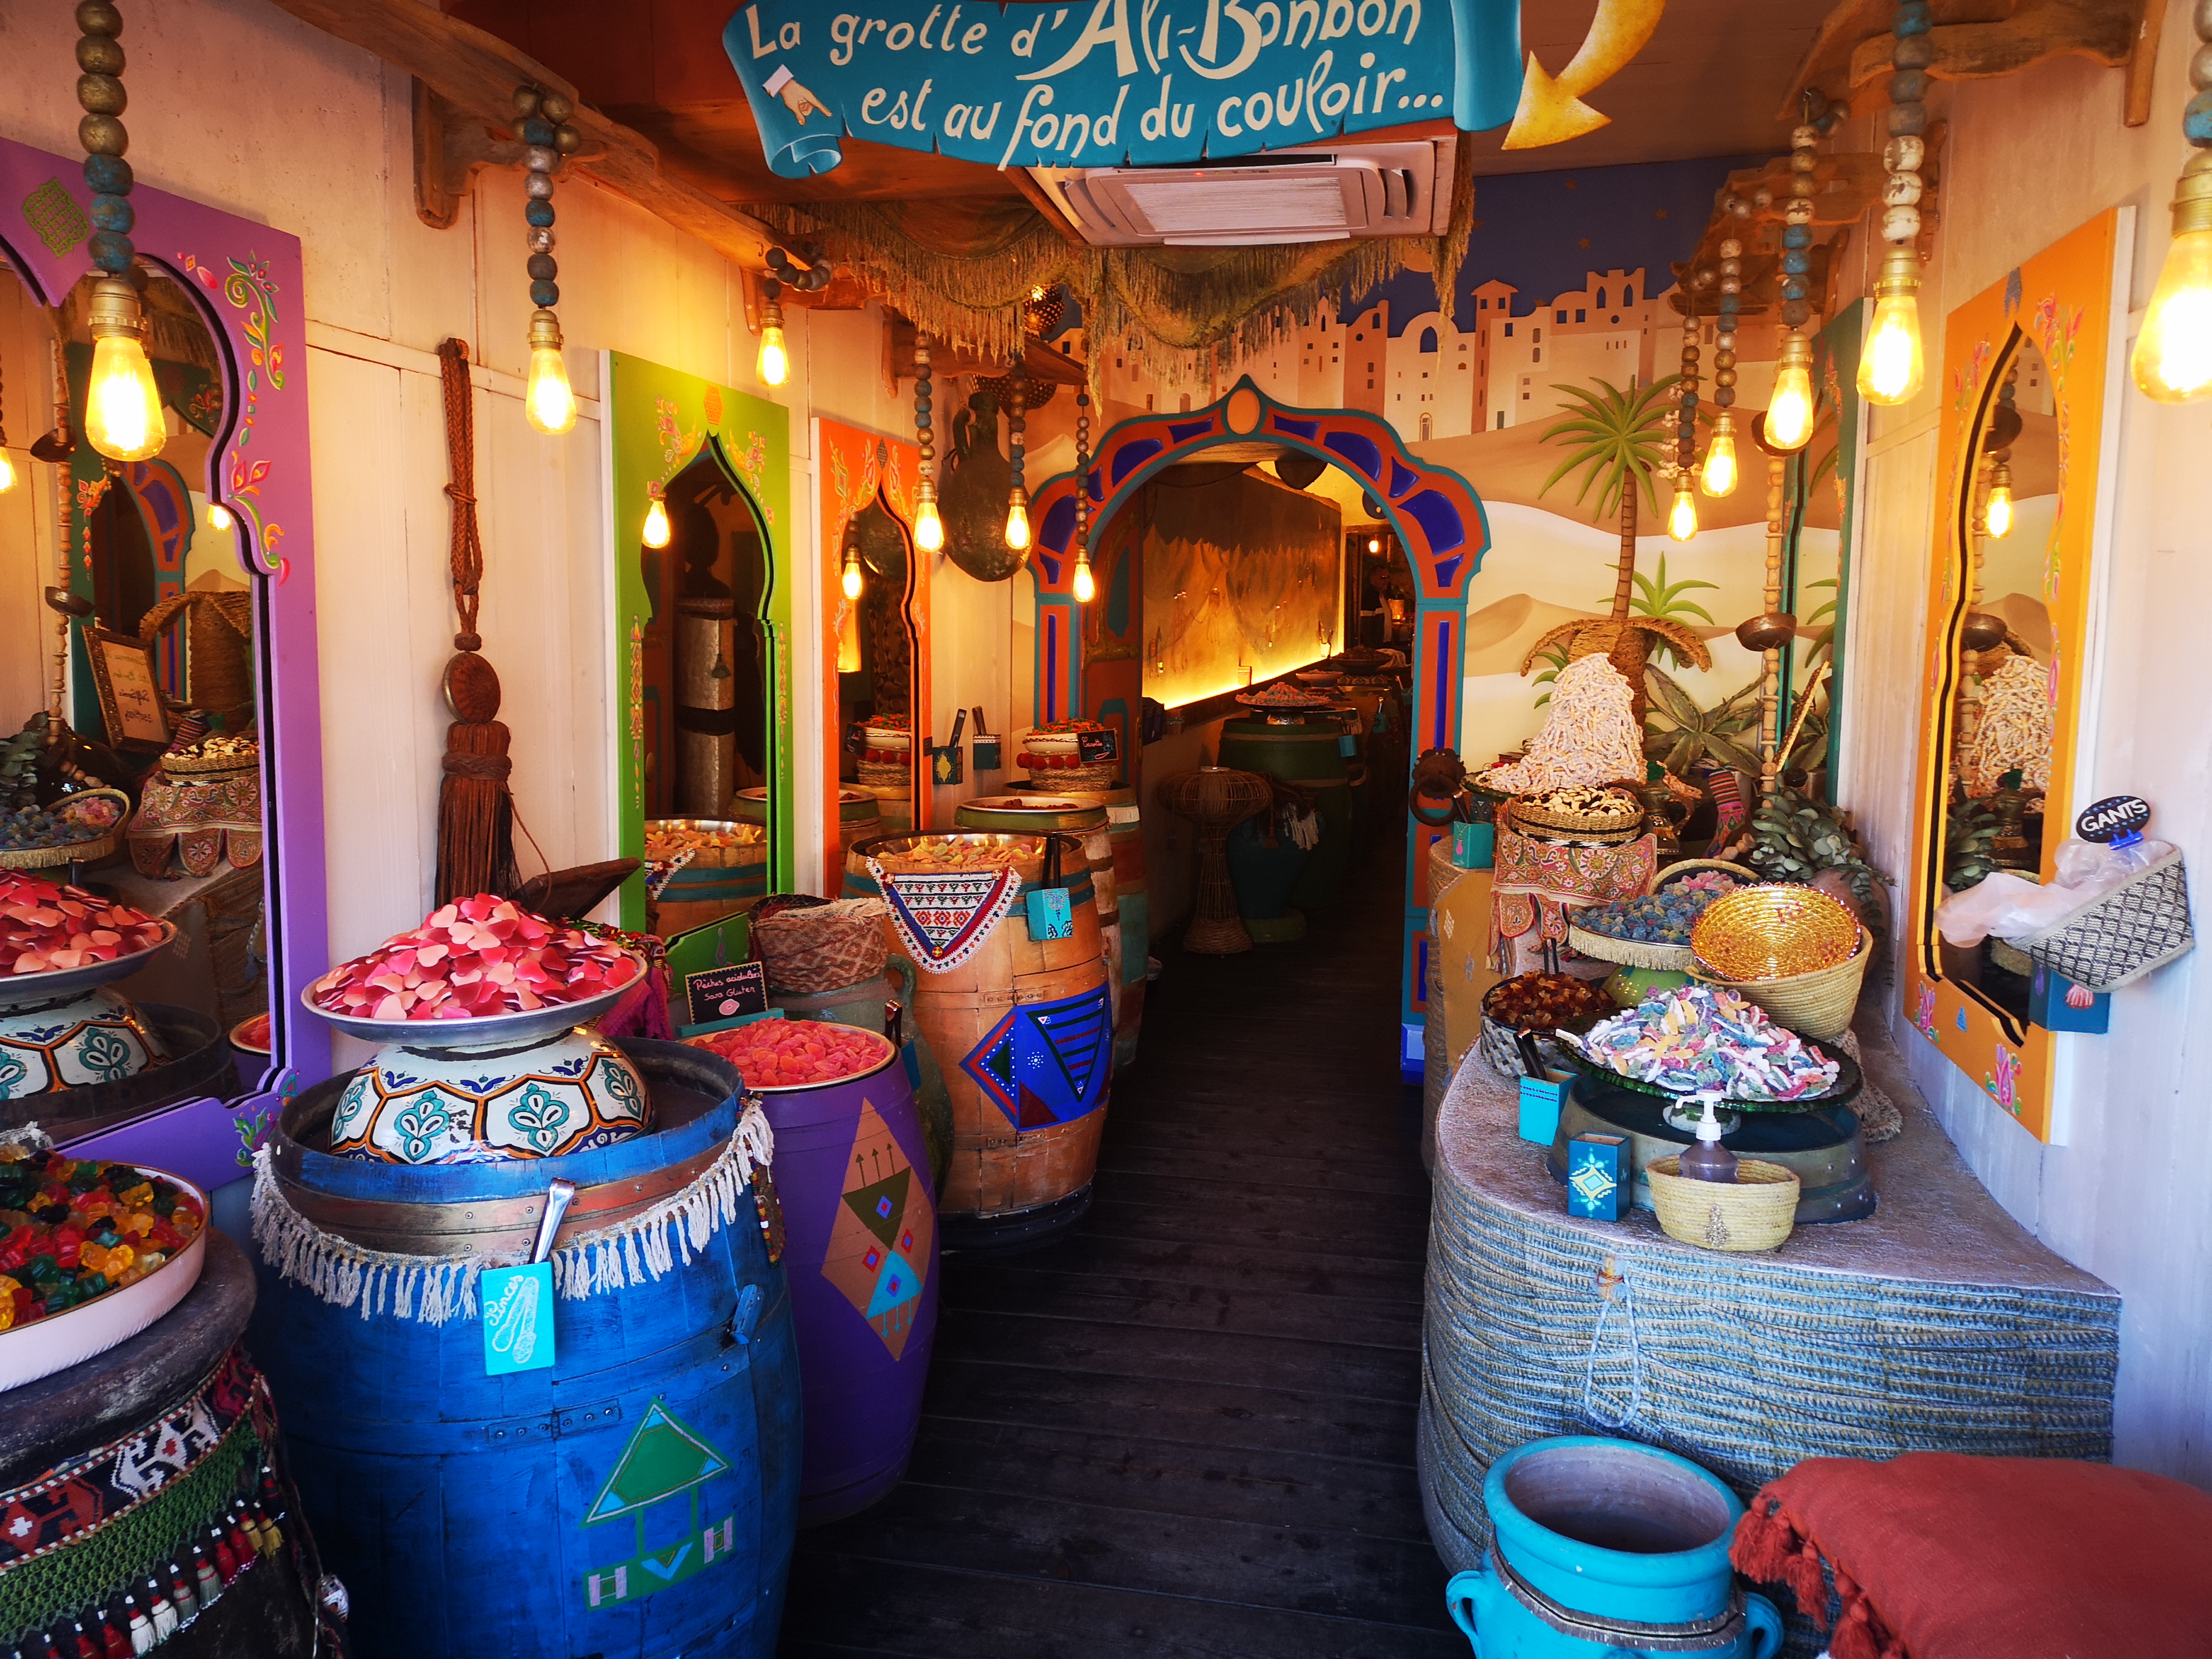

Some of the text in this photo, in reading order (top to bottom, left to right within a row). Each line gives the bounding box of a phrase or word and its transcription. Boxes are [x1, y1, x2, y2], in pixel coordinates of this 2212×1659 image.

[745, 4, 801, 59] La
[829, 4, 988, 65] grotte
[860, 49, 1443, 171] est au fond du couloir...
[2081, 799, 2147, 832] GANTS
[726, 985, 756, 997] Gluten
